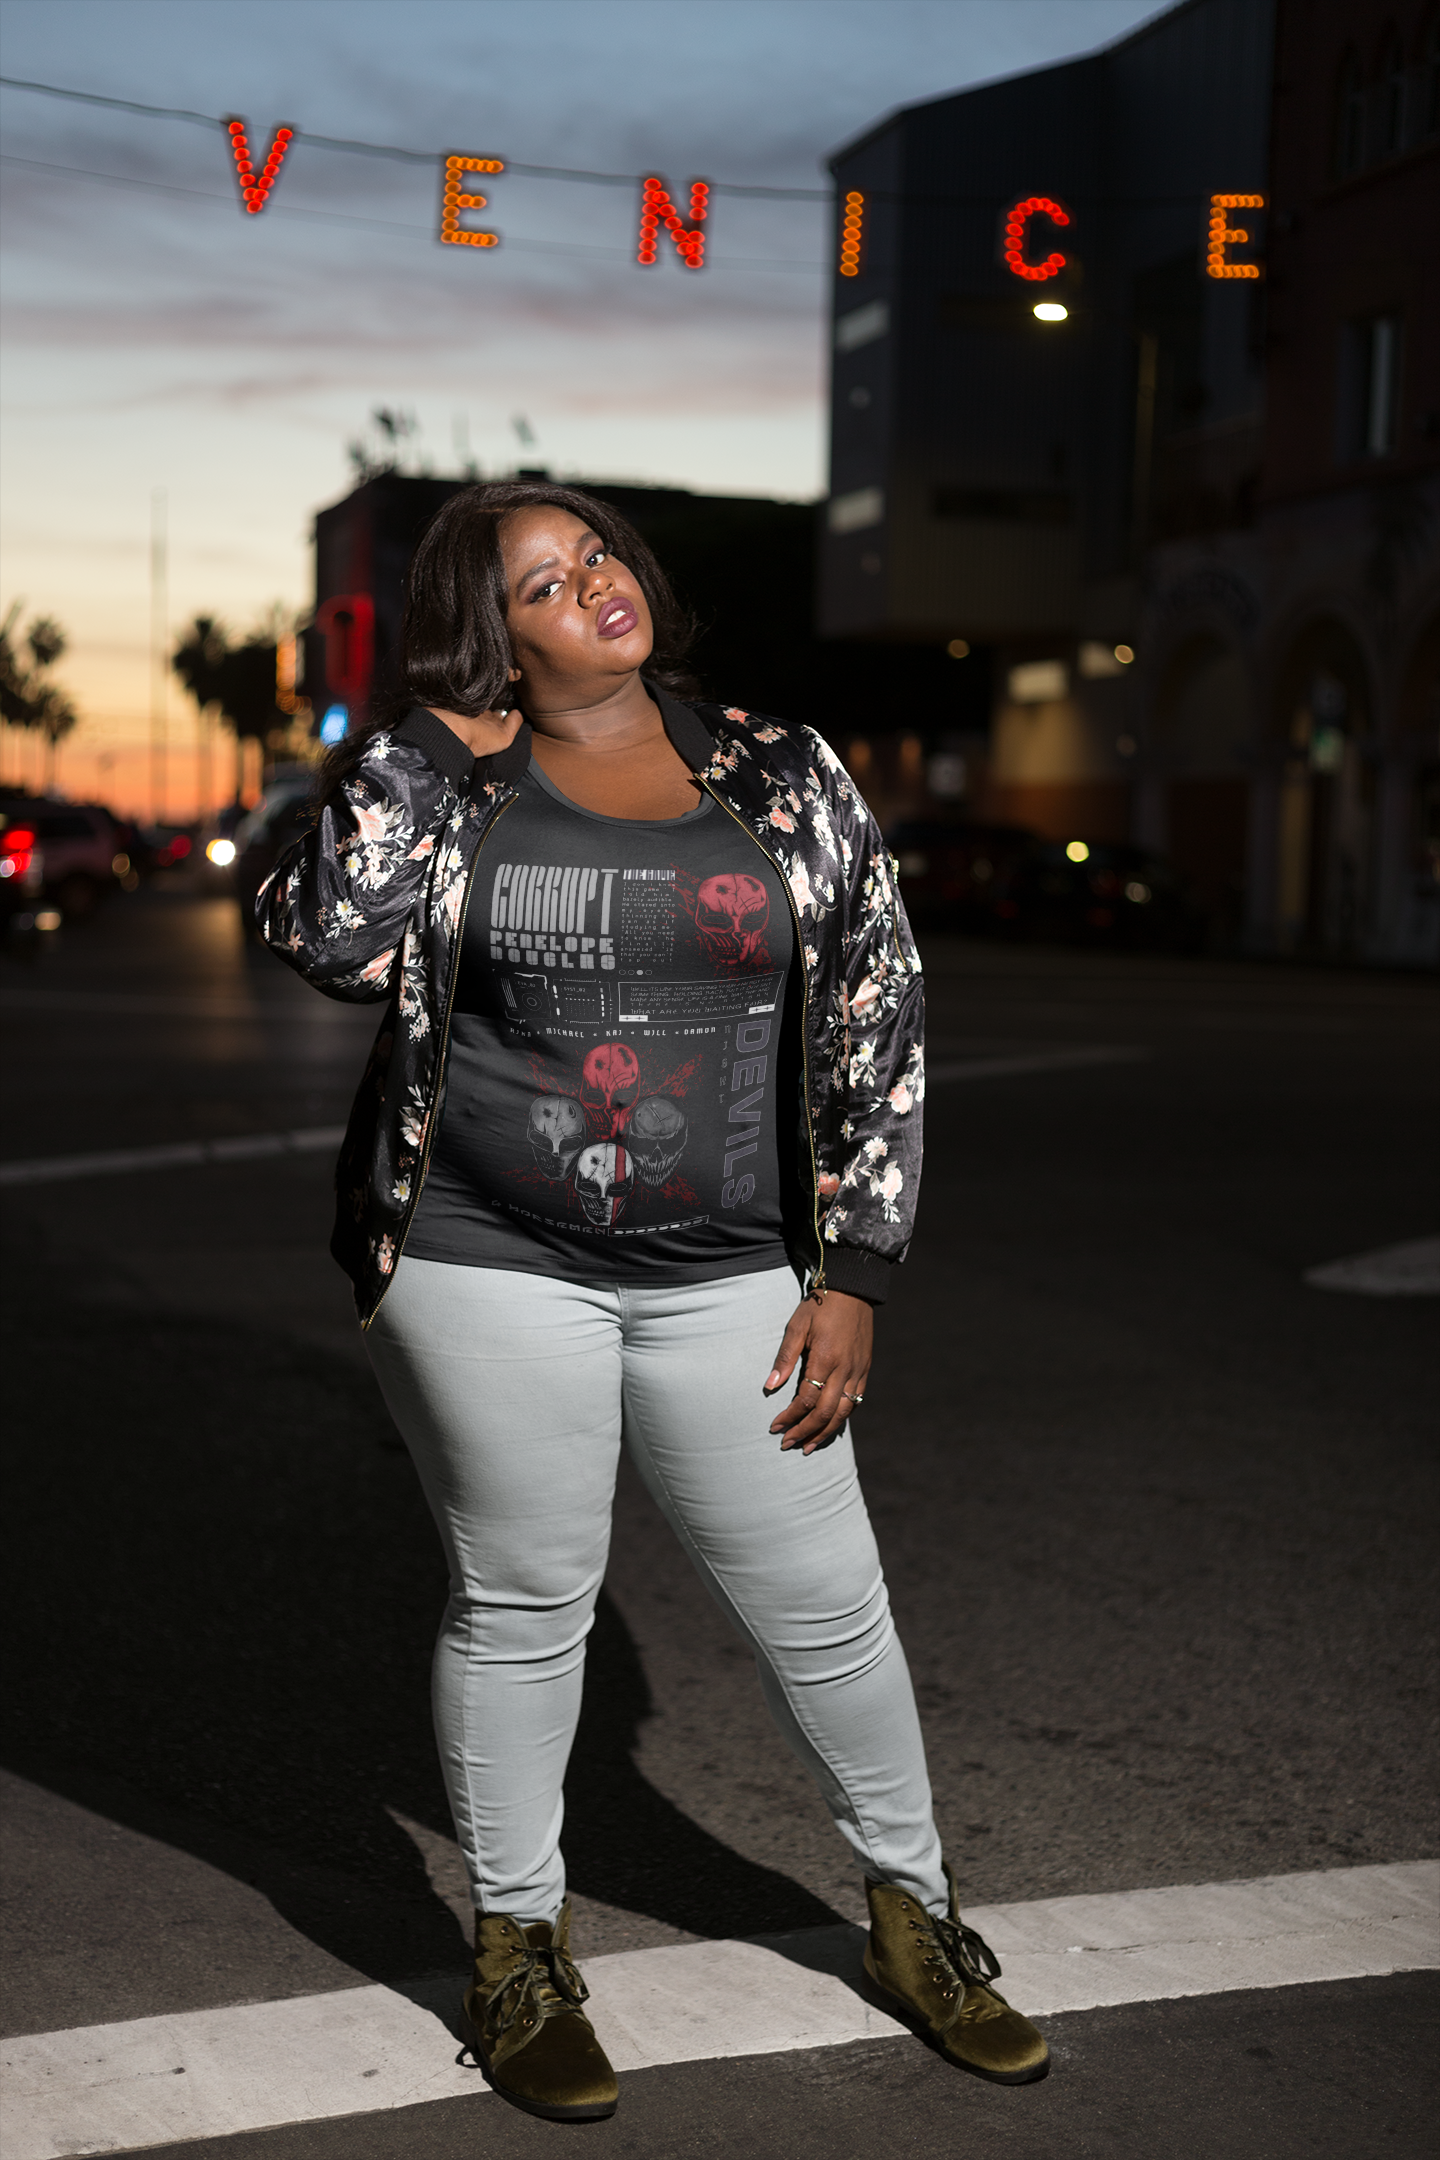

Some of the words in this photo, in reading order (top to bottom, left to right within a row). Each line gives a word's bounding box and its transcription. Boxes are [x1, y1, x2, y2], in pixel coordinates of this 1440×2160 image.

[225, 117, 1265, 280] VENICE
[490, 864, 619, 935] CORRUPT
[490, 930, 613, 953] PENELOPE
[490, 946, 615, 970] DOUGLAS
[546, 1027, 585, 1038] MICHAEL
[683, 1026, 716, 1035] DAMON
[721, 1019, 772, 1208] DEVILS
[508, 1204, 606, 1235] HORSEMEN
